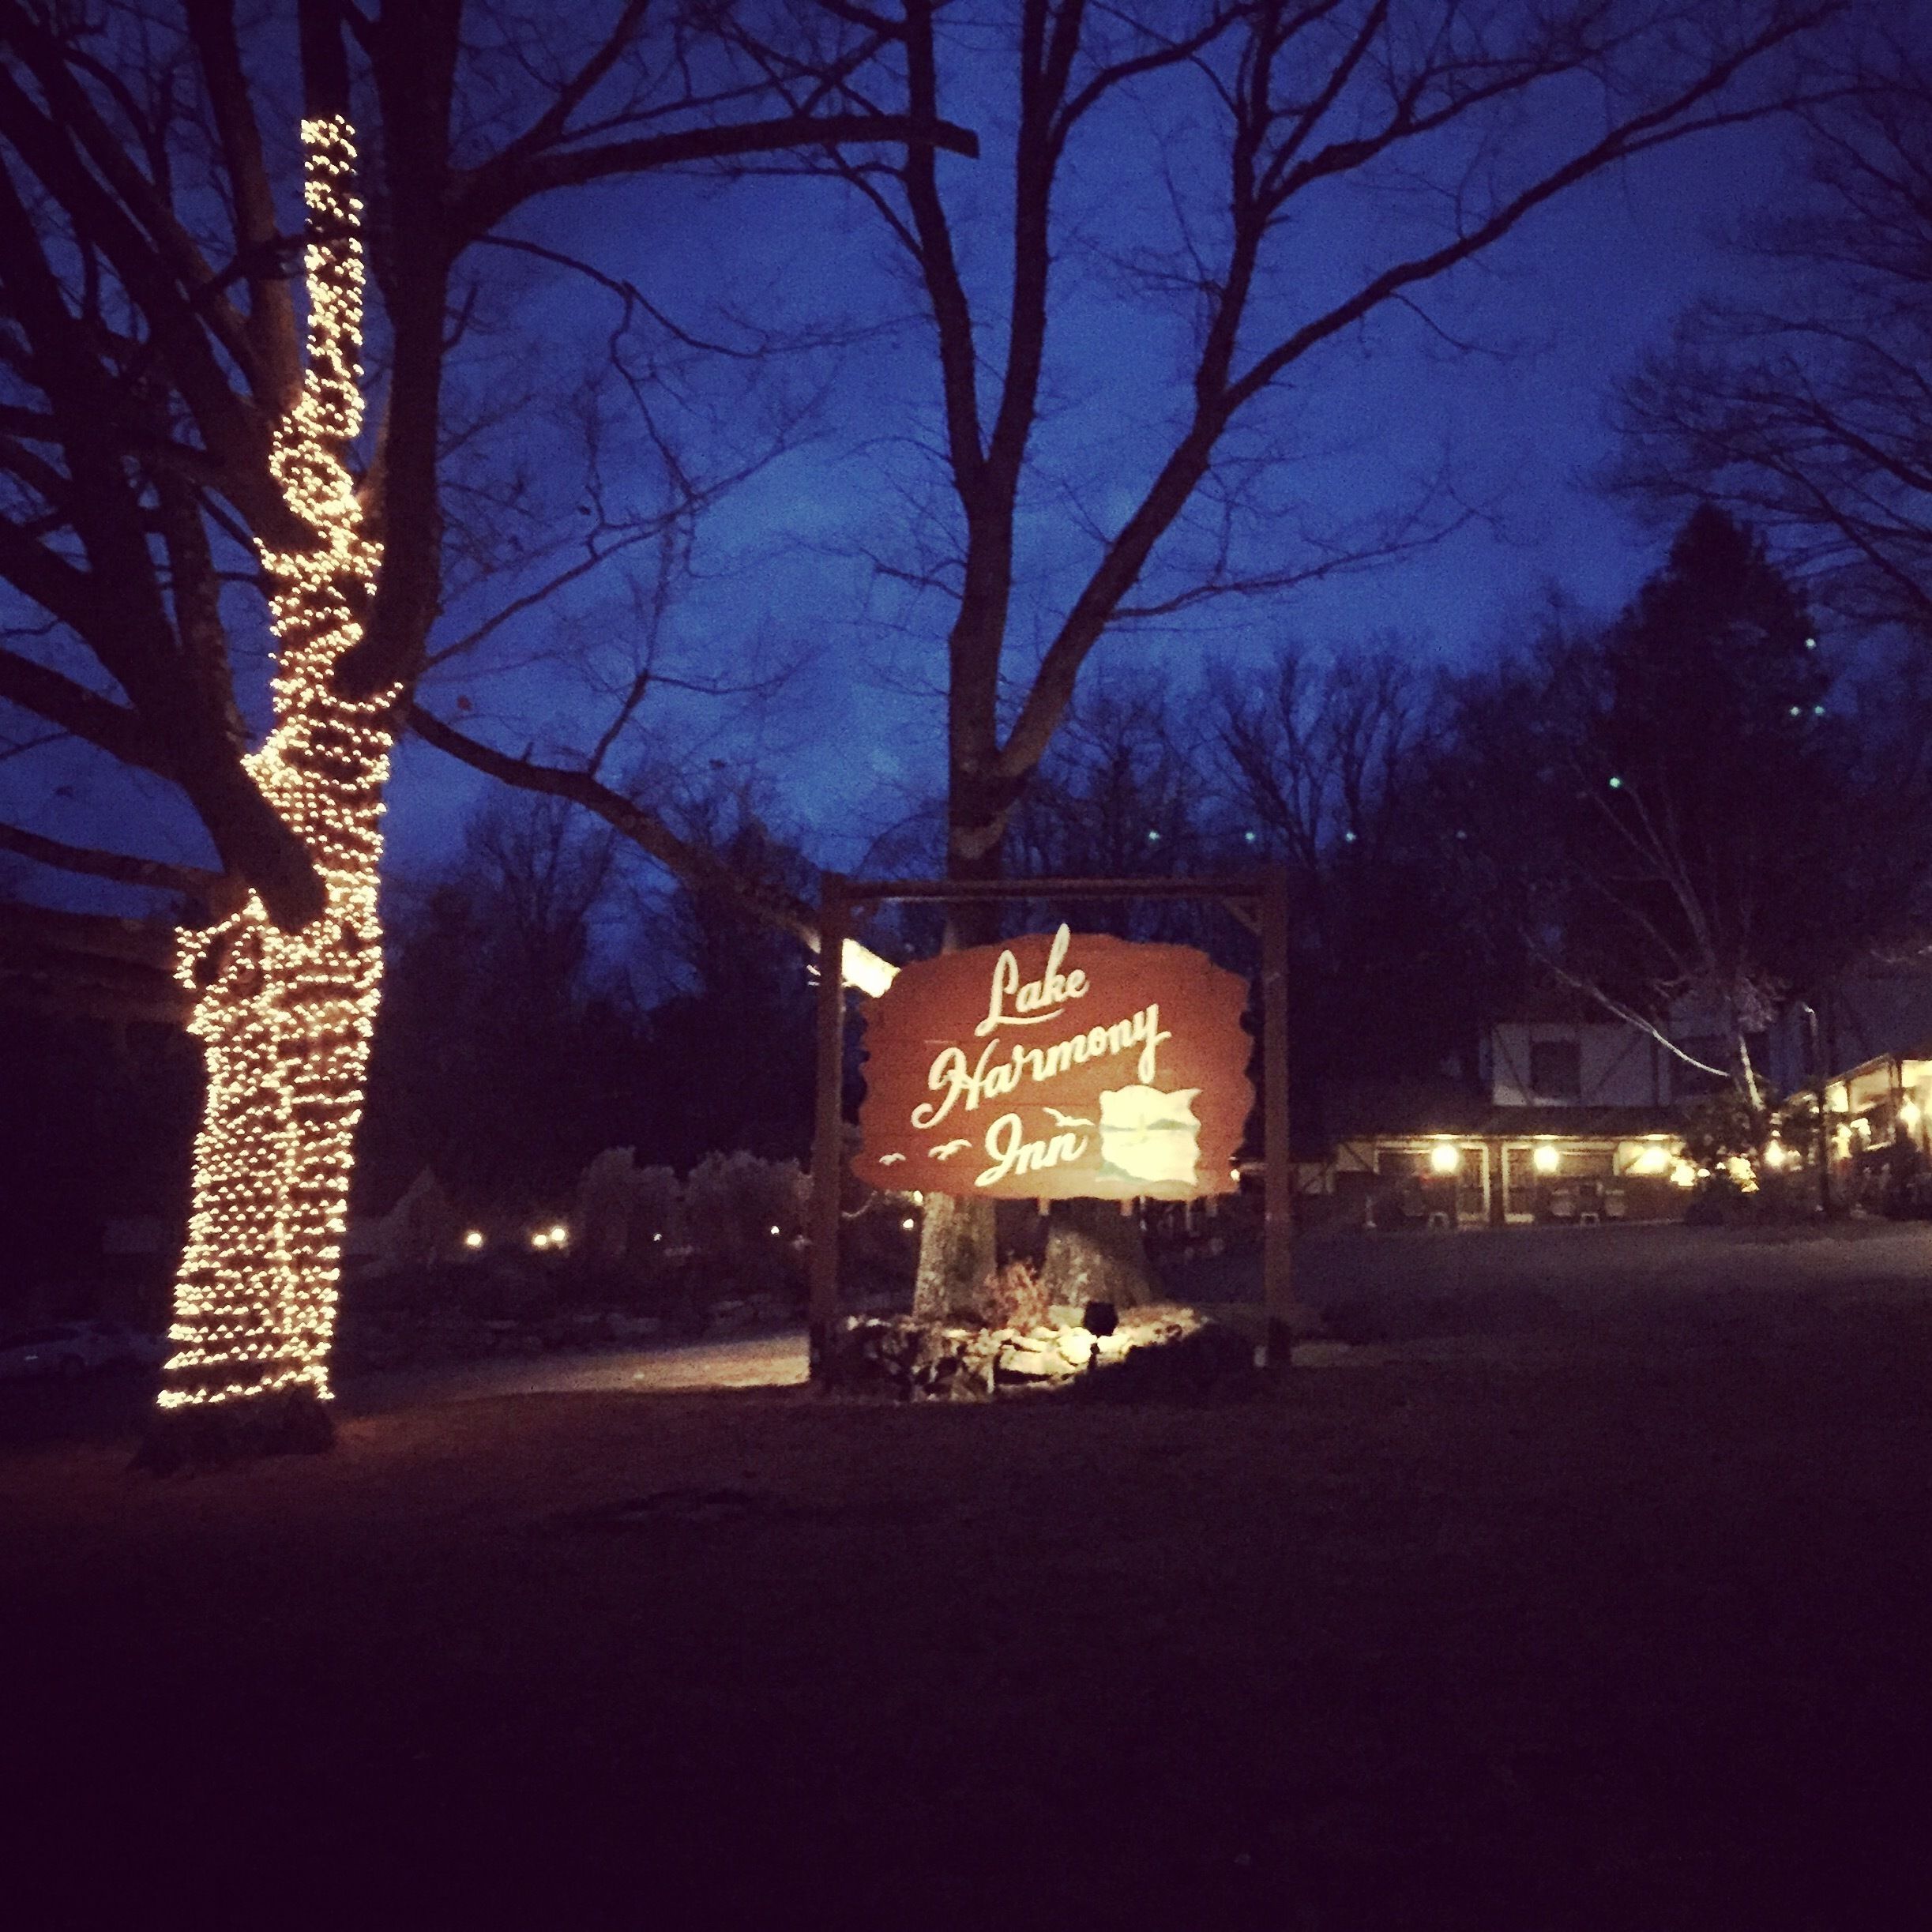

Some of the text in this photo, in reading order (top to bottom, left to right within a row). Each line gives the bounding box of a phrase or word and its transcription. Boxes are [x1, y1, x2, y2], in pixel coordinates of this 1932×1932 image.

[974, 923, 1089, 1036] Lake
[910, 1003, 1171, 1130] Harmony
[973, 1112, 1088, 1186] Inn
